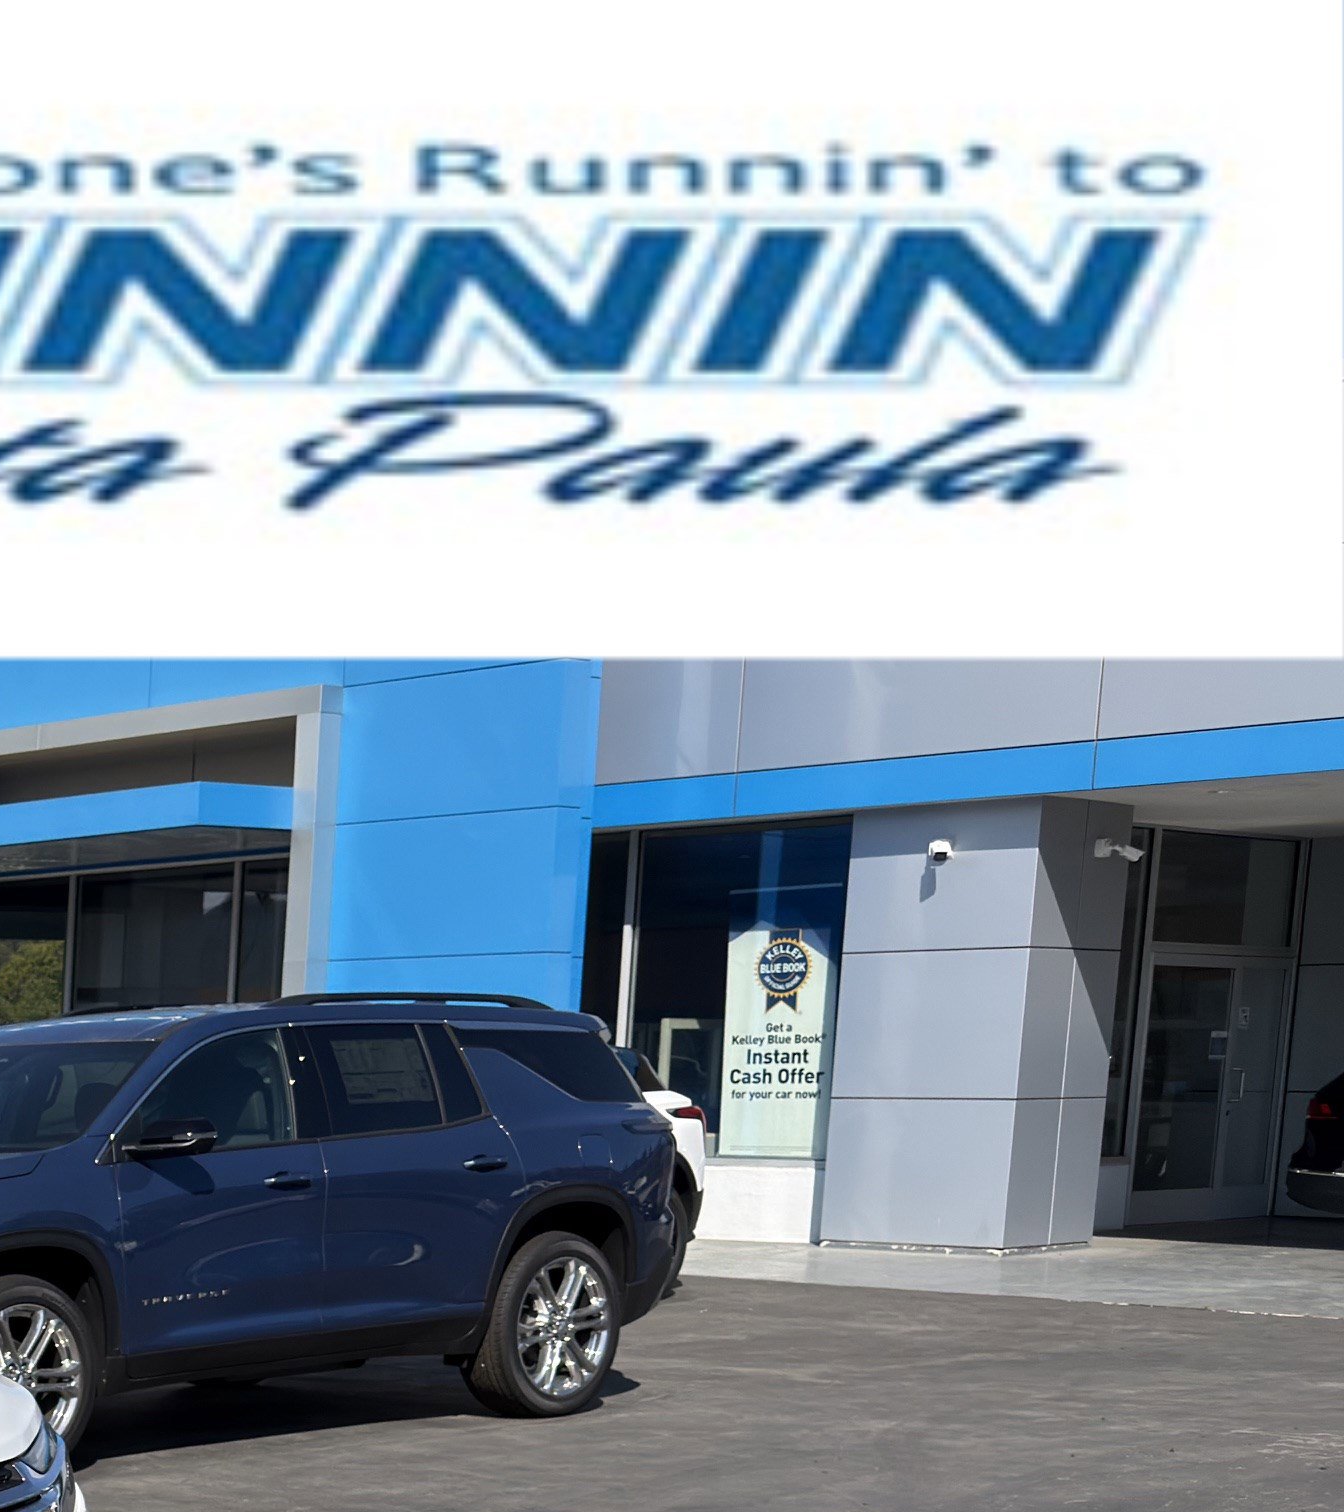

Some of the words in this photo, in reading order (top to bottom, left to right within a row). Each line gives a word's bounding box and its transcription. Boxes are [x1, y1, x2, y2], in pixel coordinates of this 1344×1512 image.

[765, 944, 804, 961] KELLEY
[760, 963, 782, 974] BLUE
[783, 961, 806, 973] BOOK
[766, 1023, 784, 1033] Get
[732, 1035, 765, 1047] Kelley
[768, 1034, 792, 1045] Blue
[747, 1049, 809, 1065] Instant
[730, 1069, 772, 1084] Cash
[778, 1068, 824, 1084] Offer
[732, 1090, 746, 1099] for
[749, 1092, 772, 1101] your
[775, 1091, 792, 1099] car
[794, 1089, 821, 1099] now!
